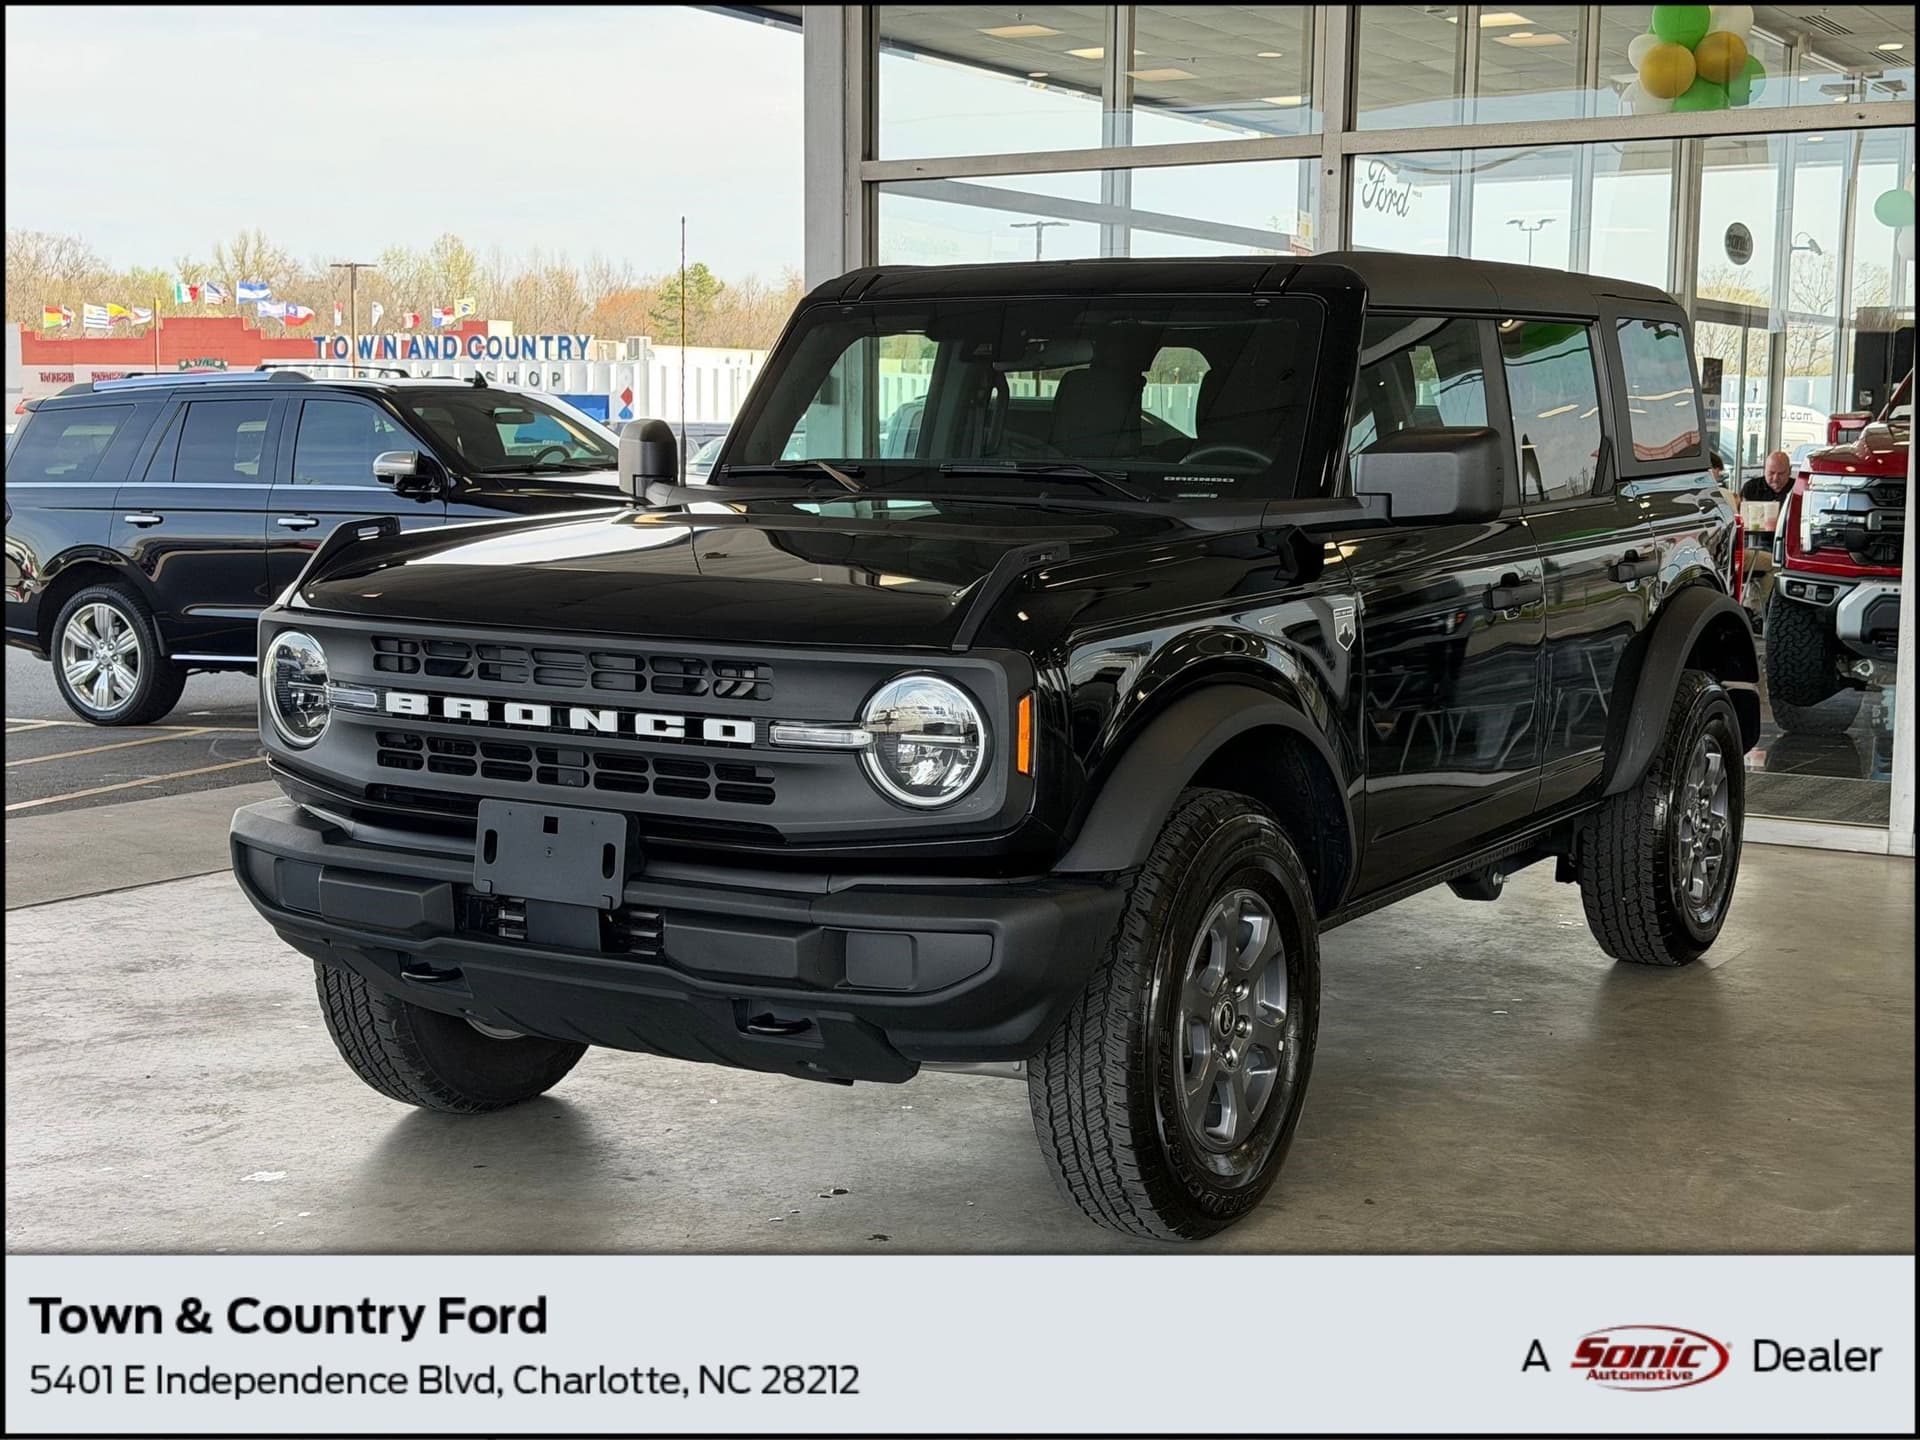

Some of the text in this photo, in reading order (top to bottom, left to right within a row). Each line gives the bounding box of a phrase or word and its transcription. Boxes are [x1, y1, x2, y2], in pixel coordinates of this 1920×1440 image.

[1362, 159, 1412, 217] Ford
[313, 335, 591, 360] TOWN AND COUNTRY
[484, 371, 562, 387] SHOP
[385, 691, 755, 745] BRONCO
